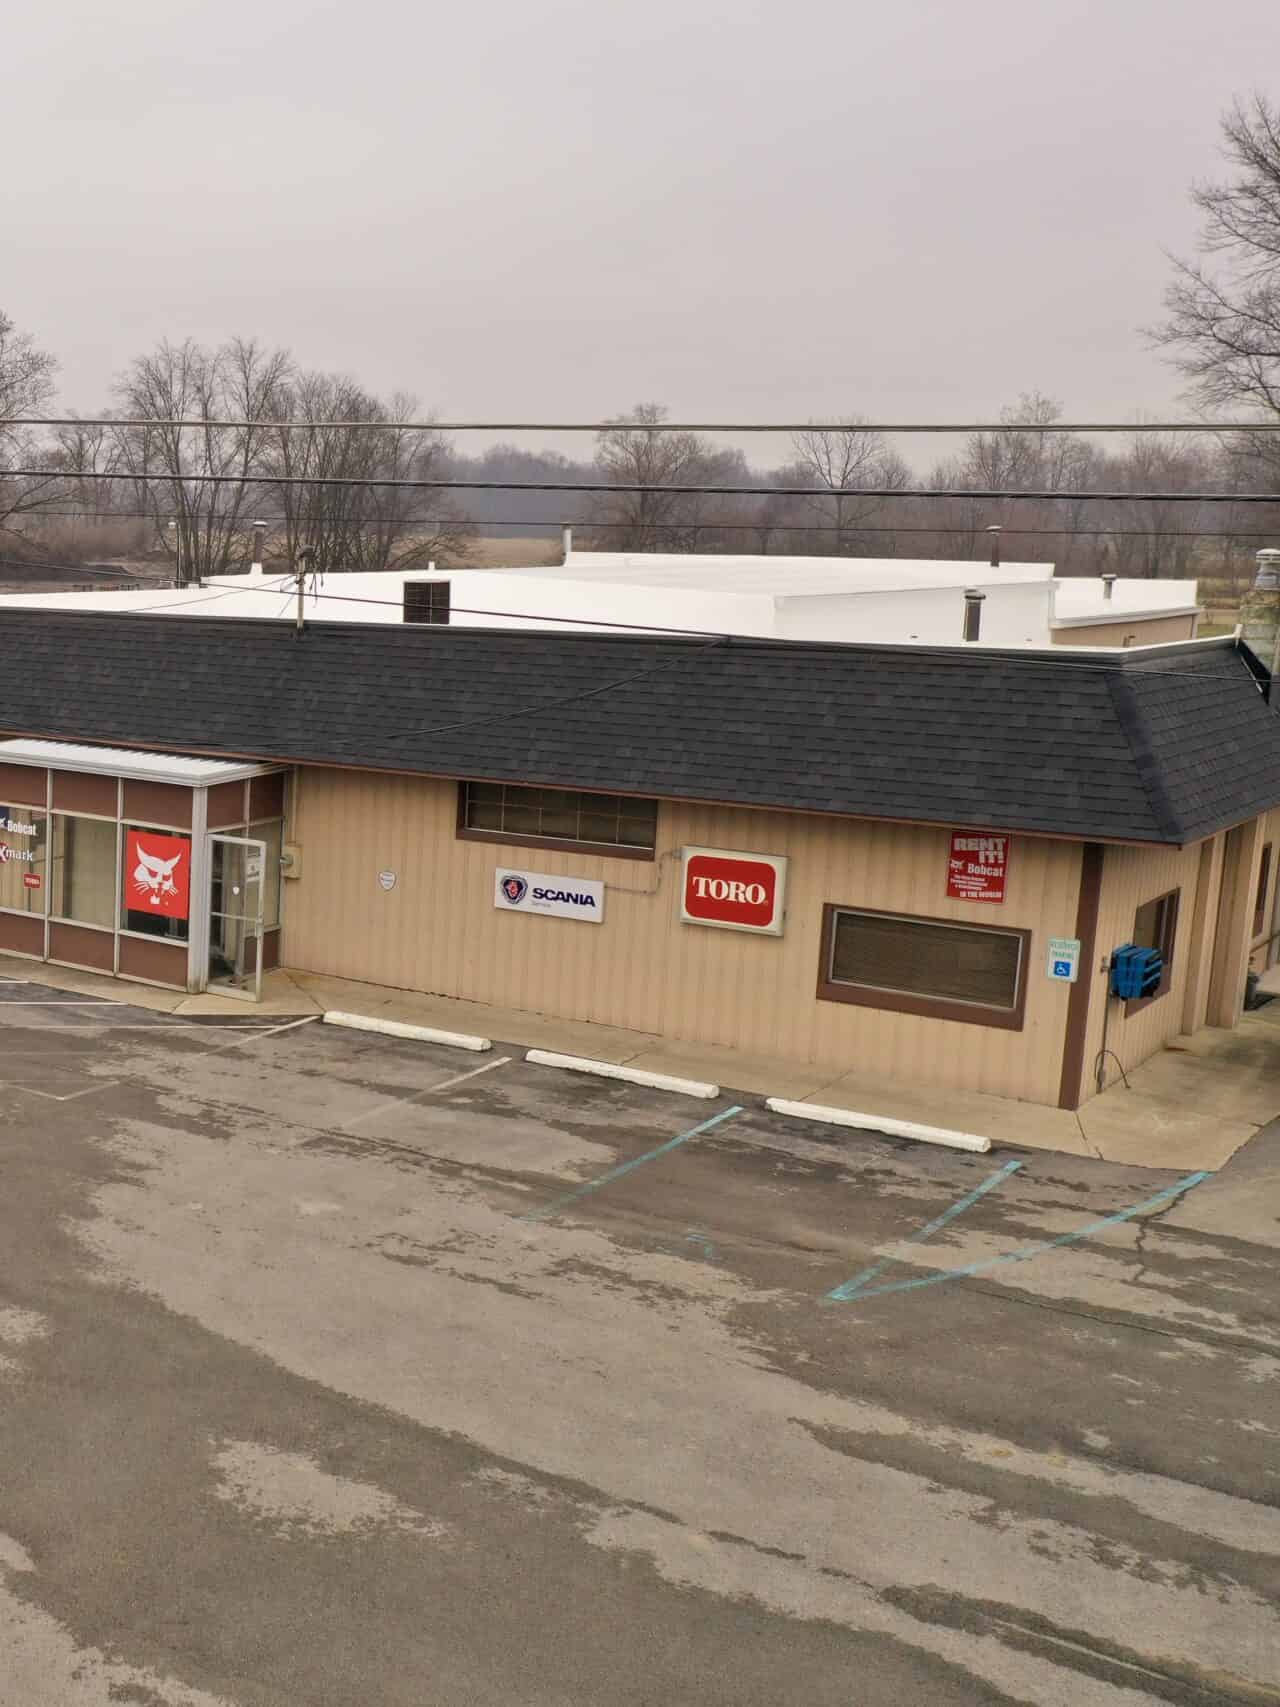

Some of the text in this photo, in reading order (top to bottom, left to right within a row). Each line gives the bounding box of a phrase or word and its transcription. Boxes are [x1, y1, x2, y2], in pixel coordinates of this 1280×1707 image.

[7, 820, 37, 836] Bobcat
[953, 838, 1007, 851] RENT
[967, 863, 1003, 878] Bobcat
[532, 887, 596, 908] SCANIA
[692, 876, 766, 905] TORO
